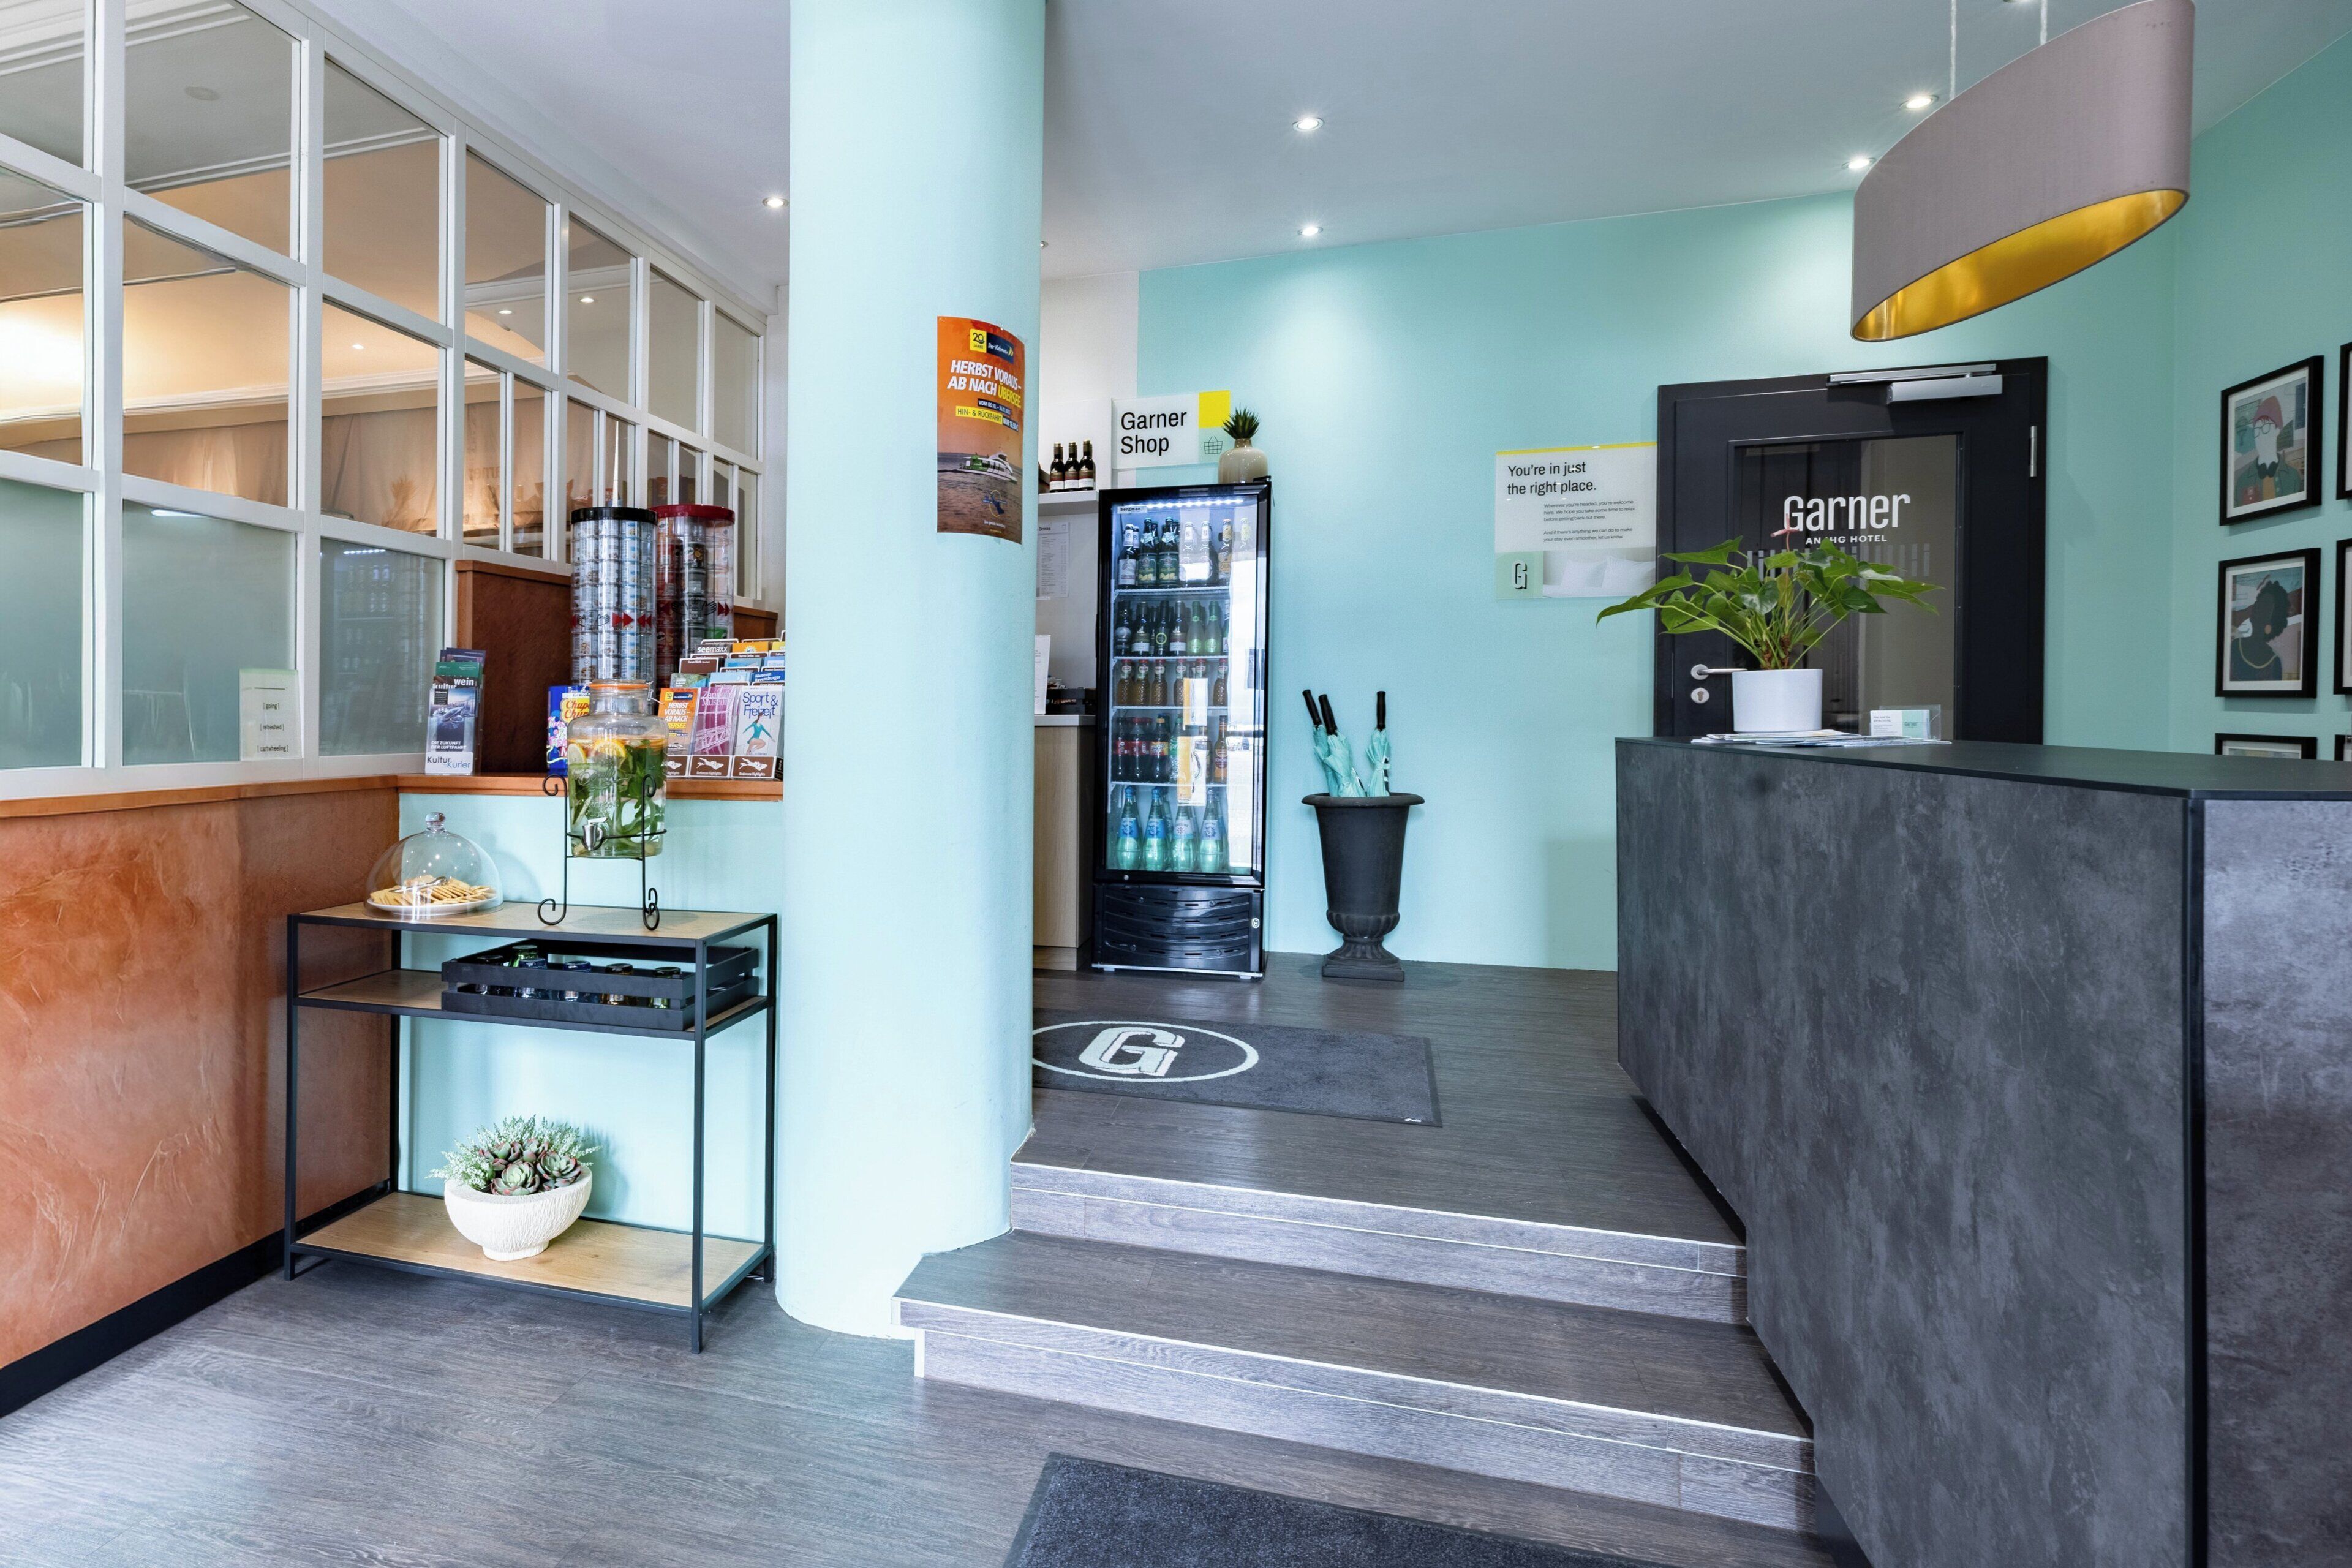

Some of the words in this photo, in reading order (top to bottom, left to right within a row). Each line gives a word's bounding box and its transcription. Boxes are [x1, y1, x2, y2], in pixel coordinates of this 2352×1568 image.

[973, 333, 984, 344] 20
[951, 360, 993, 378] HERBST
[947, 376, 967, 390] AB
[968, 377, 997, 396] NACH
[978, 410, 1001, 423] RÜCKFAHRT
[1121, 412, 1187, 431] Garner
[1121, 435, 1169, 456] Shop
[1508, 464, 1545, 477] You're
[1550, 463, 1560, 474] in
[1563, 462, 1586, 477] just
[1507, 483, 1526, 495] the
[1530, 481, 1557, 496] right
[1561, 480, 1596, 495] place.
[1784, 494, 1911, 532] Garner
[1850, 534, 1888, 543] HOTEL
[1514, 560, 1528, 589] G
[453, 677, 474, 686] wein
[566, 700, 589, 710] Chup
[742, 692, 769, 706] Sport
[770, 695, 778, 706] &
[744, 704, 775, 719] Freizeit
[1078, 1027, 1185, 1077] G
